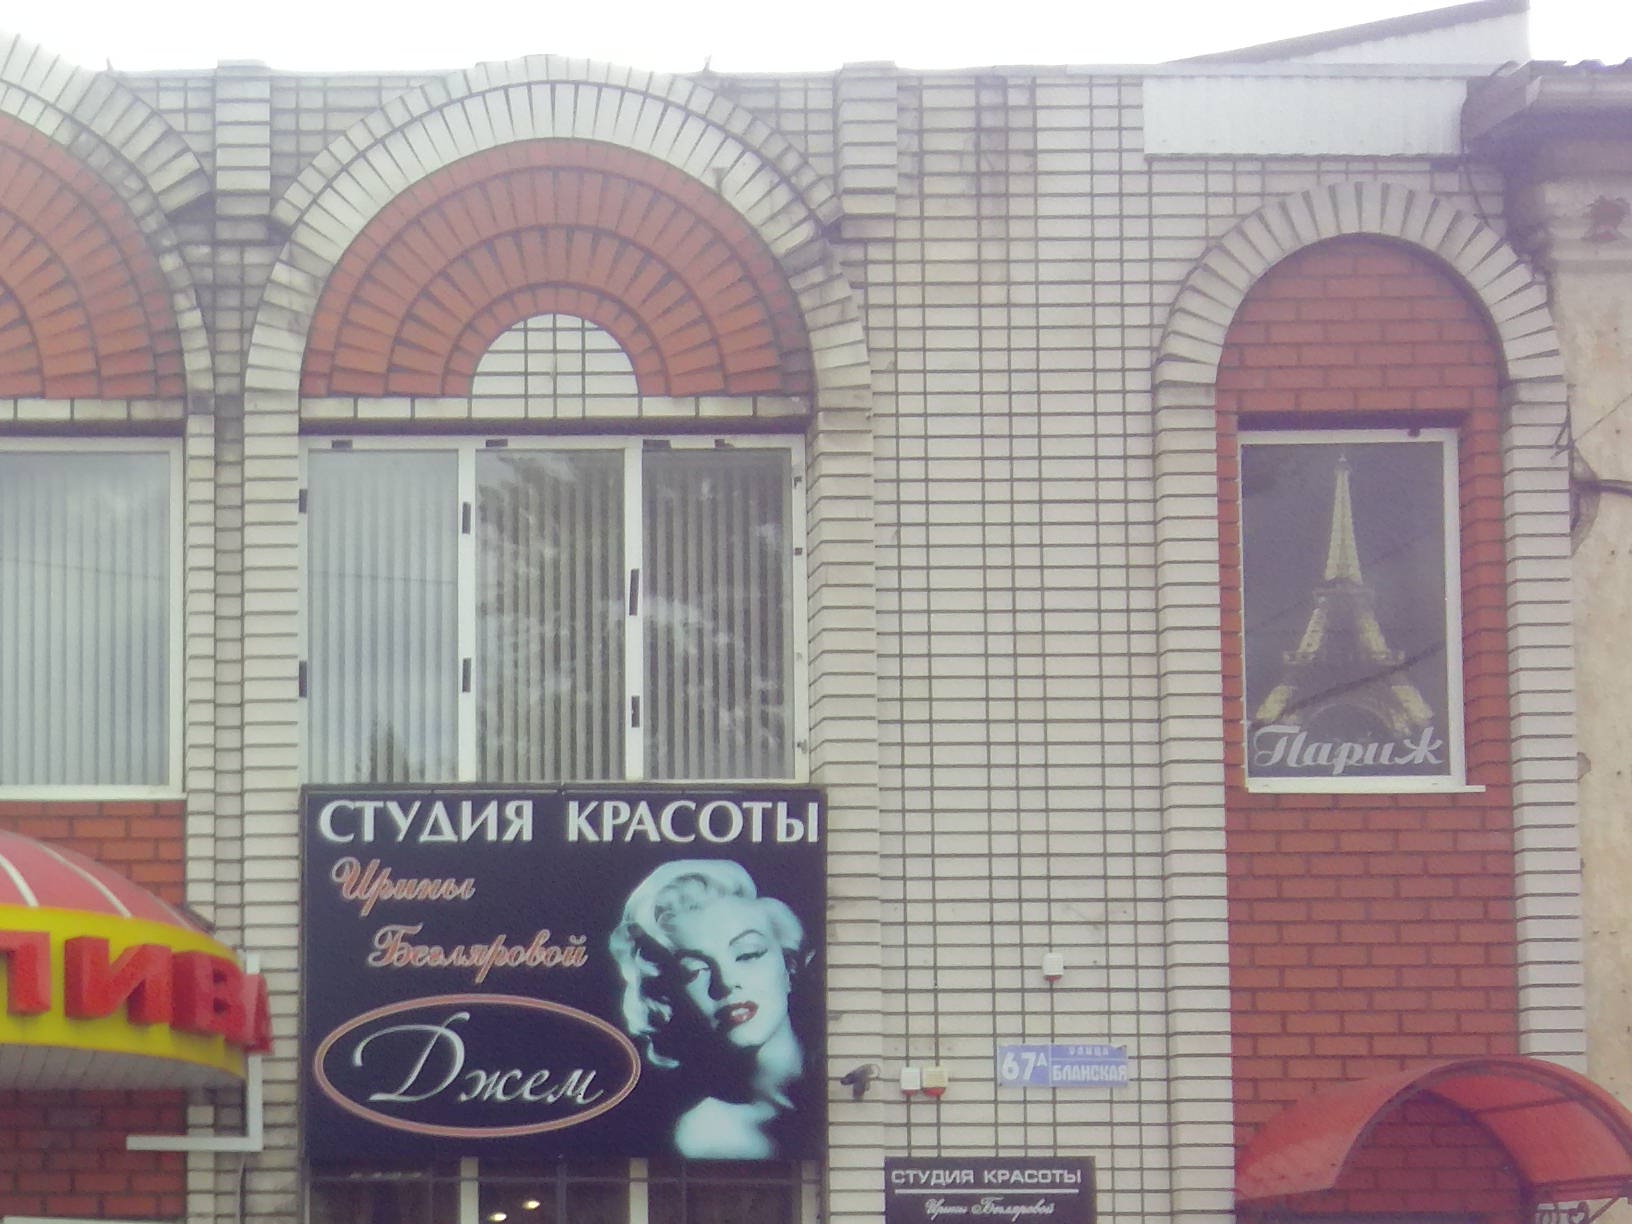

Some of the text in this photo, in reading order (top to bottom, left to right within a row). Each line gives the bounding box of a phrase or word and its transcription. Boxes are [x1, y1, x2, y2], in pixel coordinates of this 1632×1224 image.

[1252, 725, 1444, 775] Париж
[319, 800, 819, 844] СТУДИЯ КРАСОТЫ
[331, 856, 476, 917] Ирины
[352, 1012, 603, 1106] Джем
[890, 1169, 1082, 1187] СТУДИЯ КРАСОТЫ
